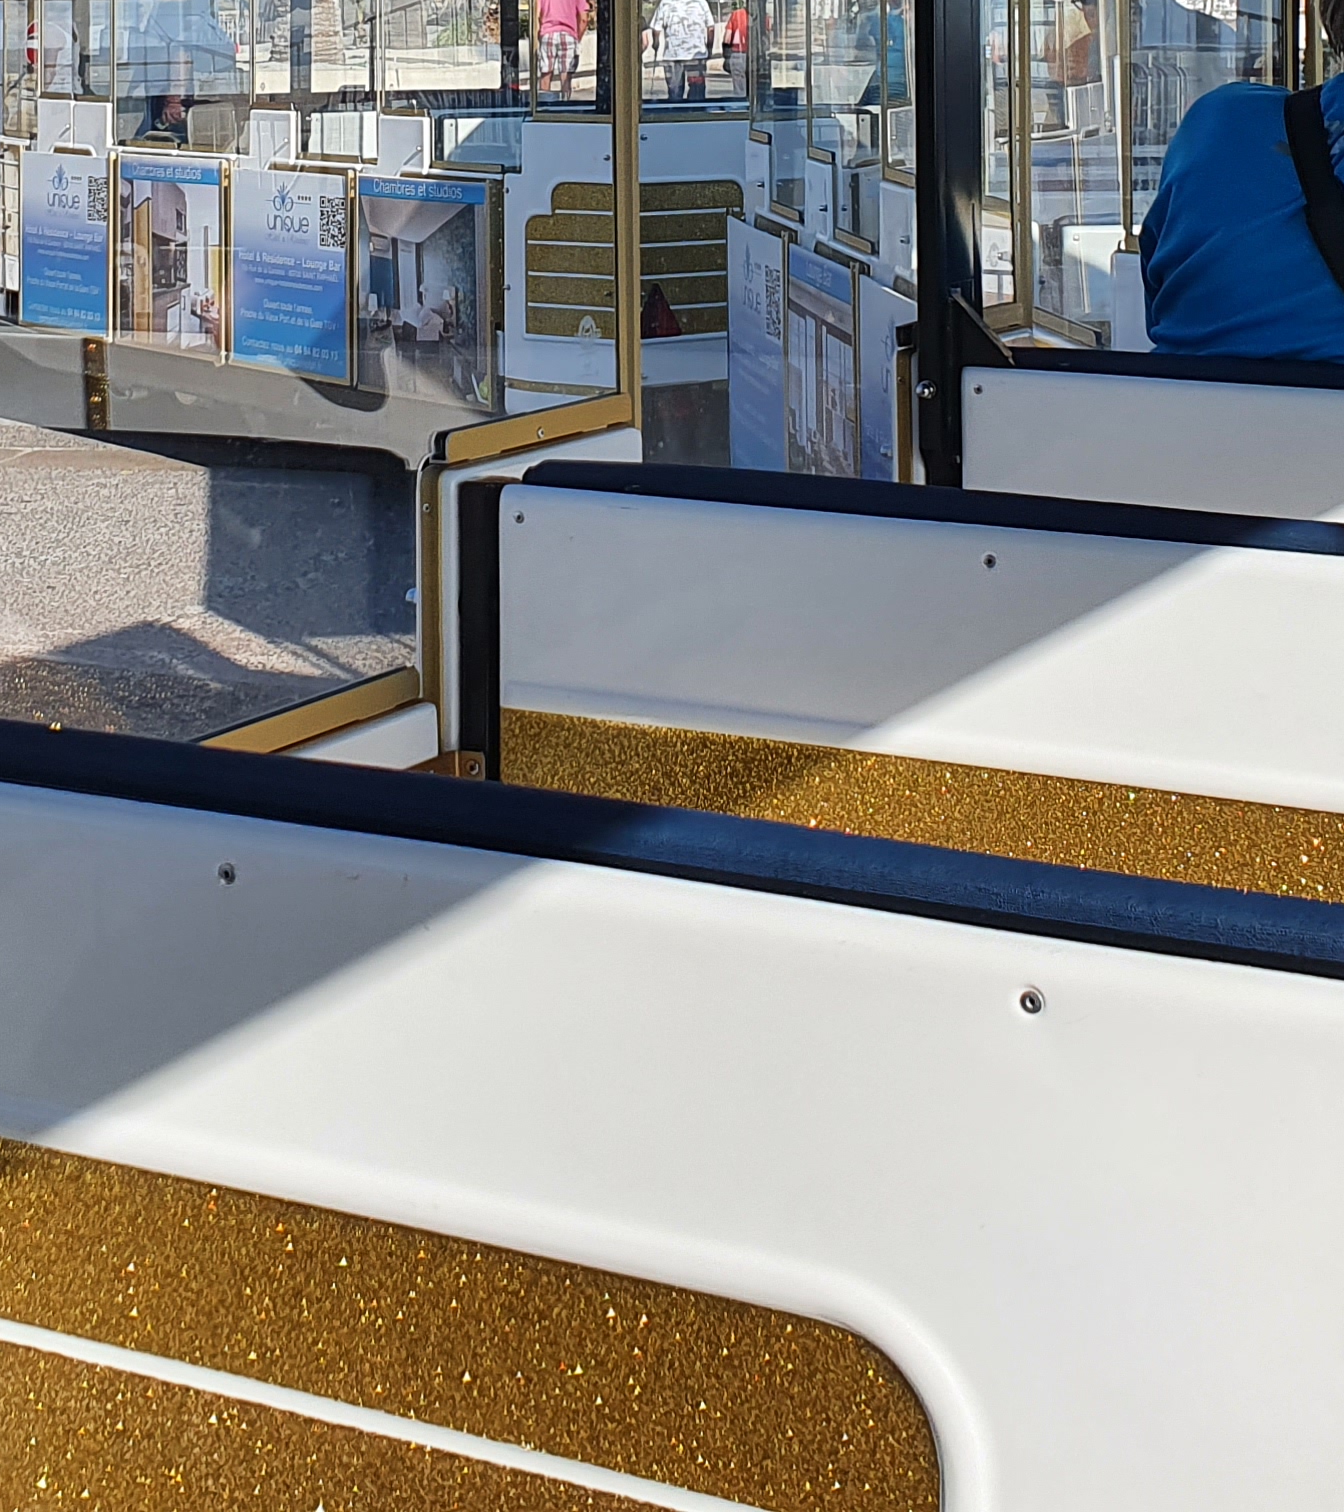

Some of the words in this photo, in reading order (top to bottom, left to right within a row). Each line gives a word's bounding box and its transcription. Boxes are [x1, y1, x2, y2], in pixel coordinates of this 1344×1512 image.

[373, 178, 416, 196] Chambres
[428, 184, 463, 199] studios
[328, 260, 341, 271] Bar
